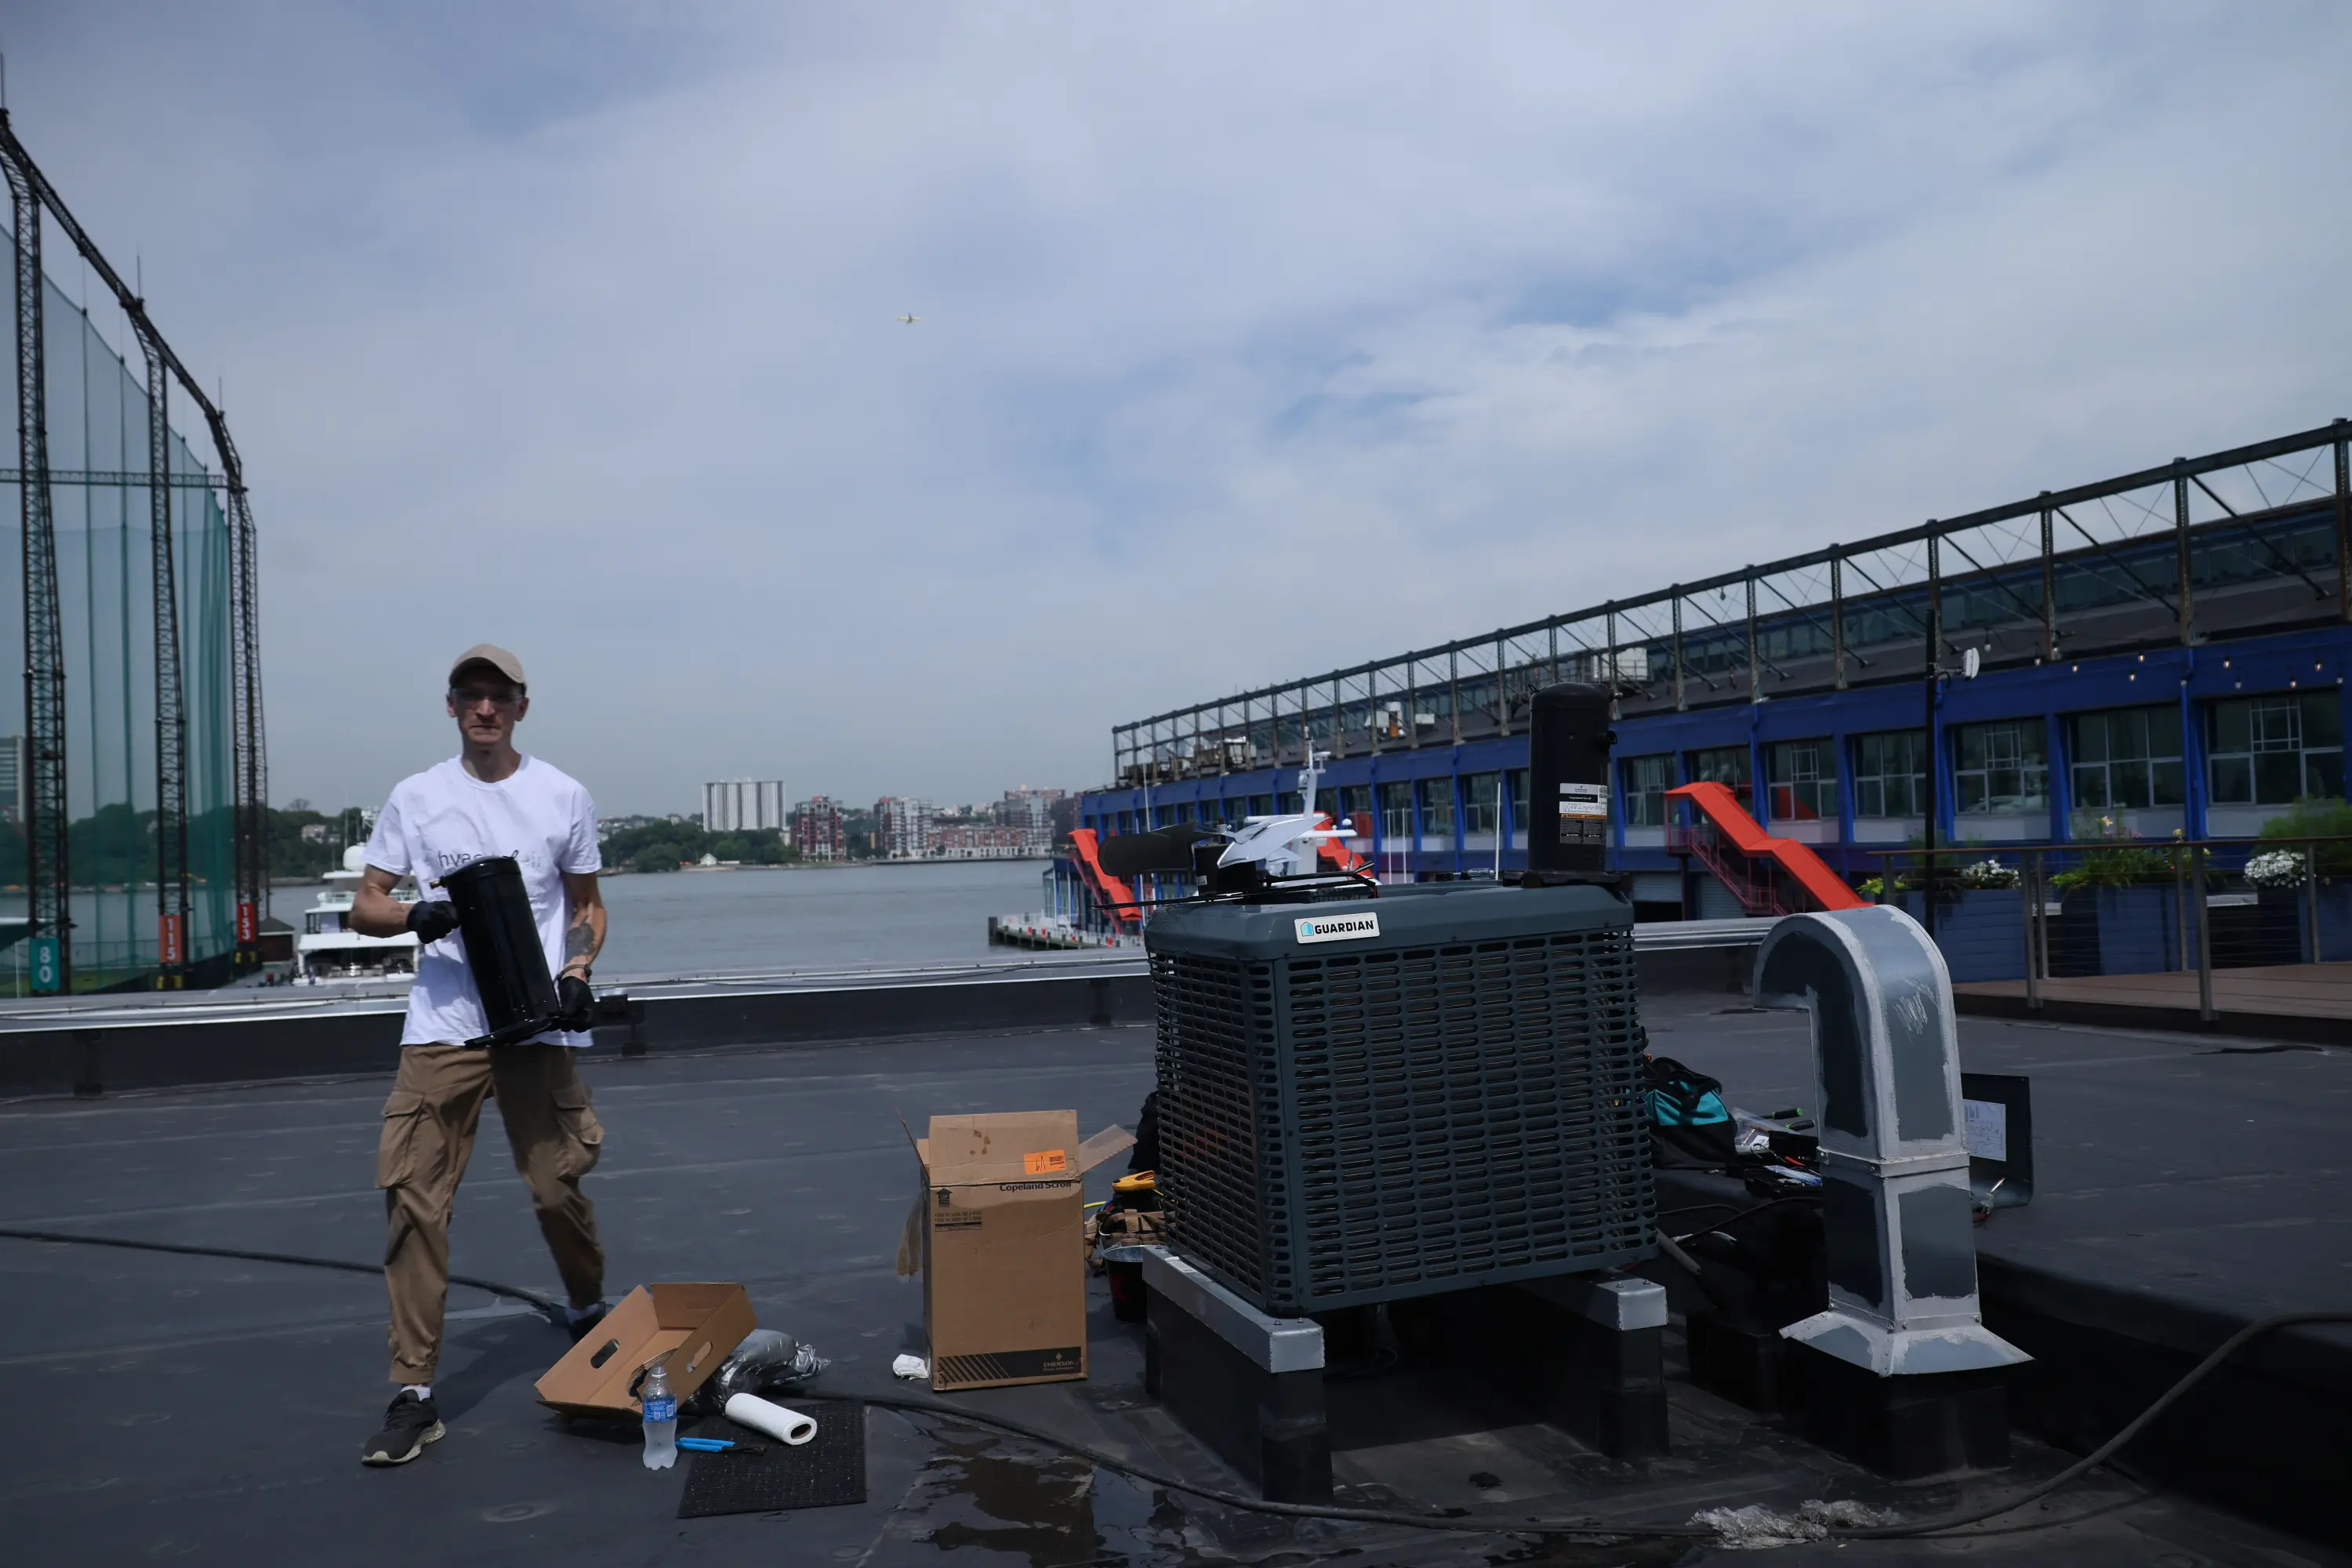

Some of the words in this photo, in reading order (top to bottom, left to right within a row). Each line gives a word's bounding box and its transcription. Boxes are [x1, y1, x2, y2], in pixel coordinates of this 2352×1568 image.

[166, 918, 176, 960] 115
[241, 906, 251, 940] 153
[1314, 920, 1374, 935] GUARDIAN
[39, 946, 52, 983] 80
[1000, 1182, 1044, 1192] Copeland
